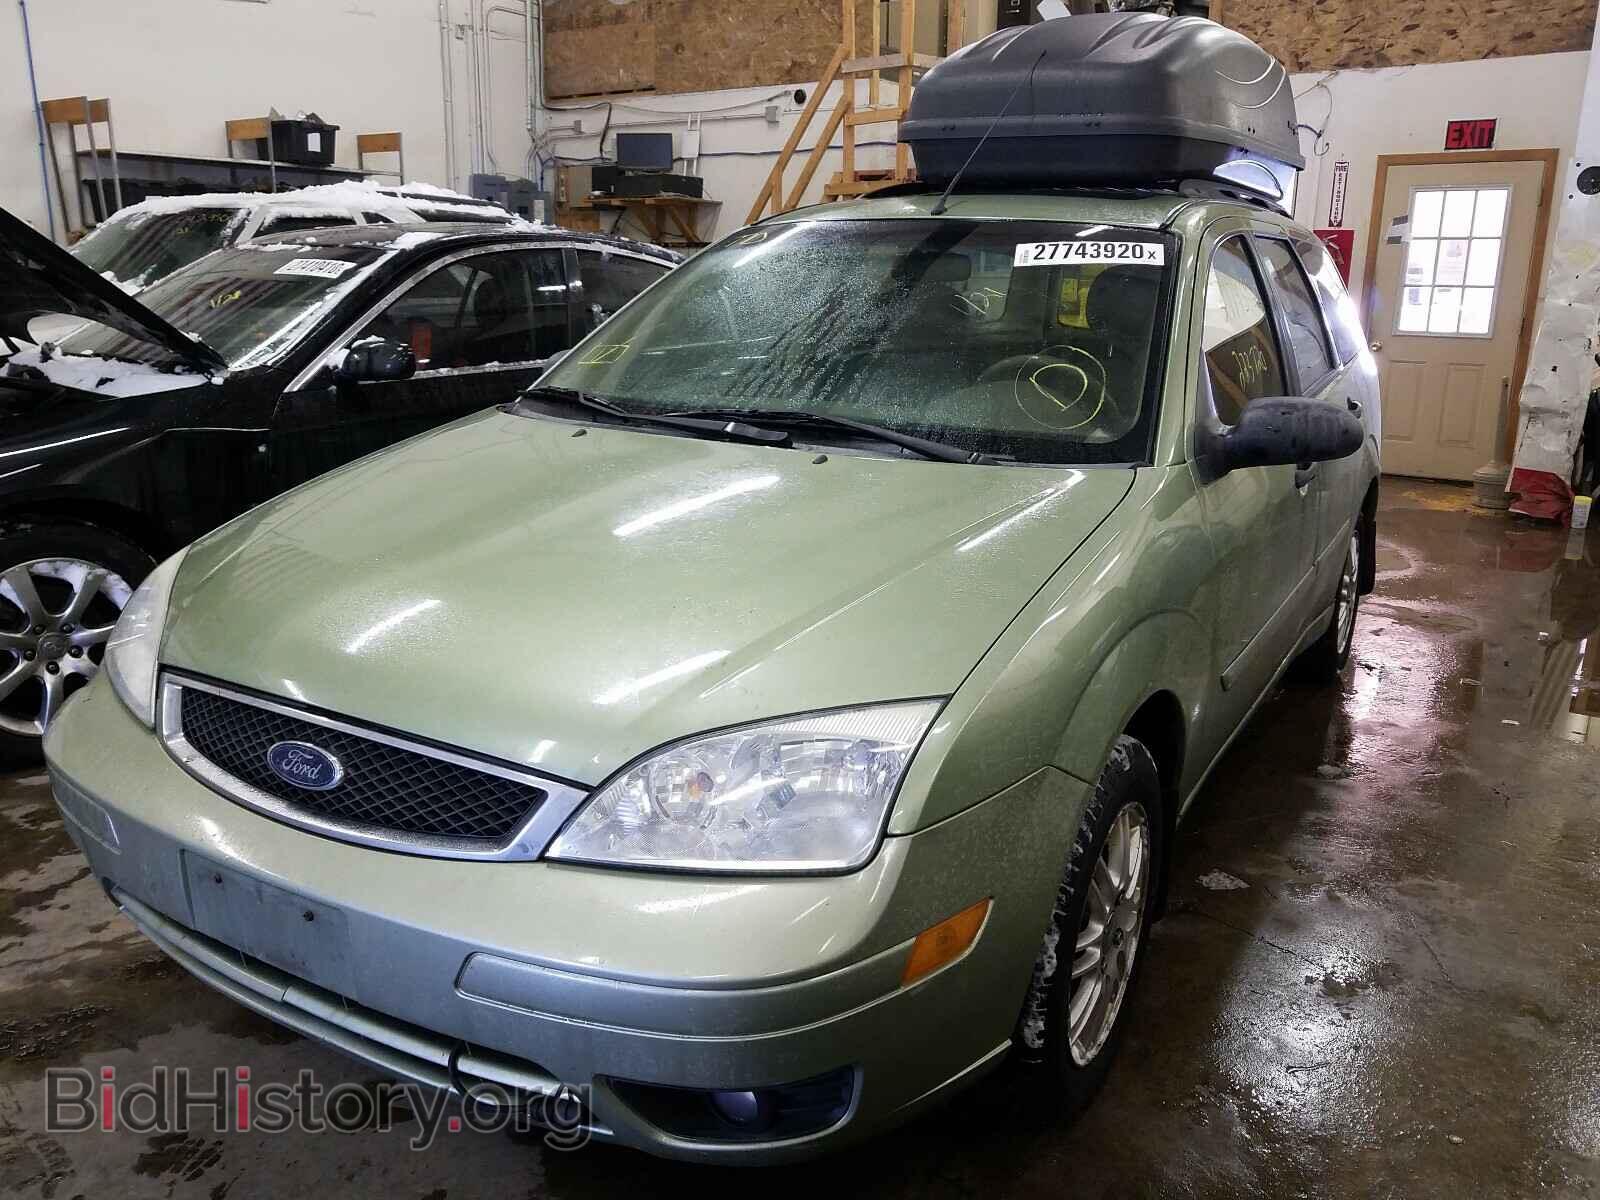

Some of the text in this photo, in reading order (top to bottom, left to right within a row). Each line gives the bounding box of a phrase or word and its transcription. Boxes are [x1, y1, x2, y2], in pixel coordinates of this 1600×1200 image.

[1447, 121, 1494, 148] EXIT
[1033, 243, 1144, 260] 27743920
[282, 749, 323, 780] Ford
